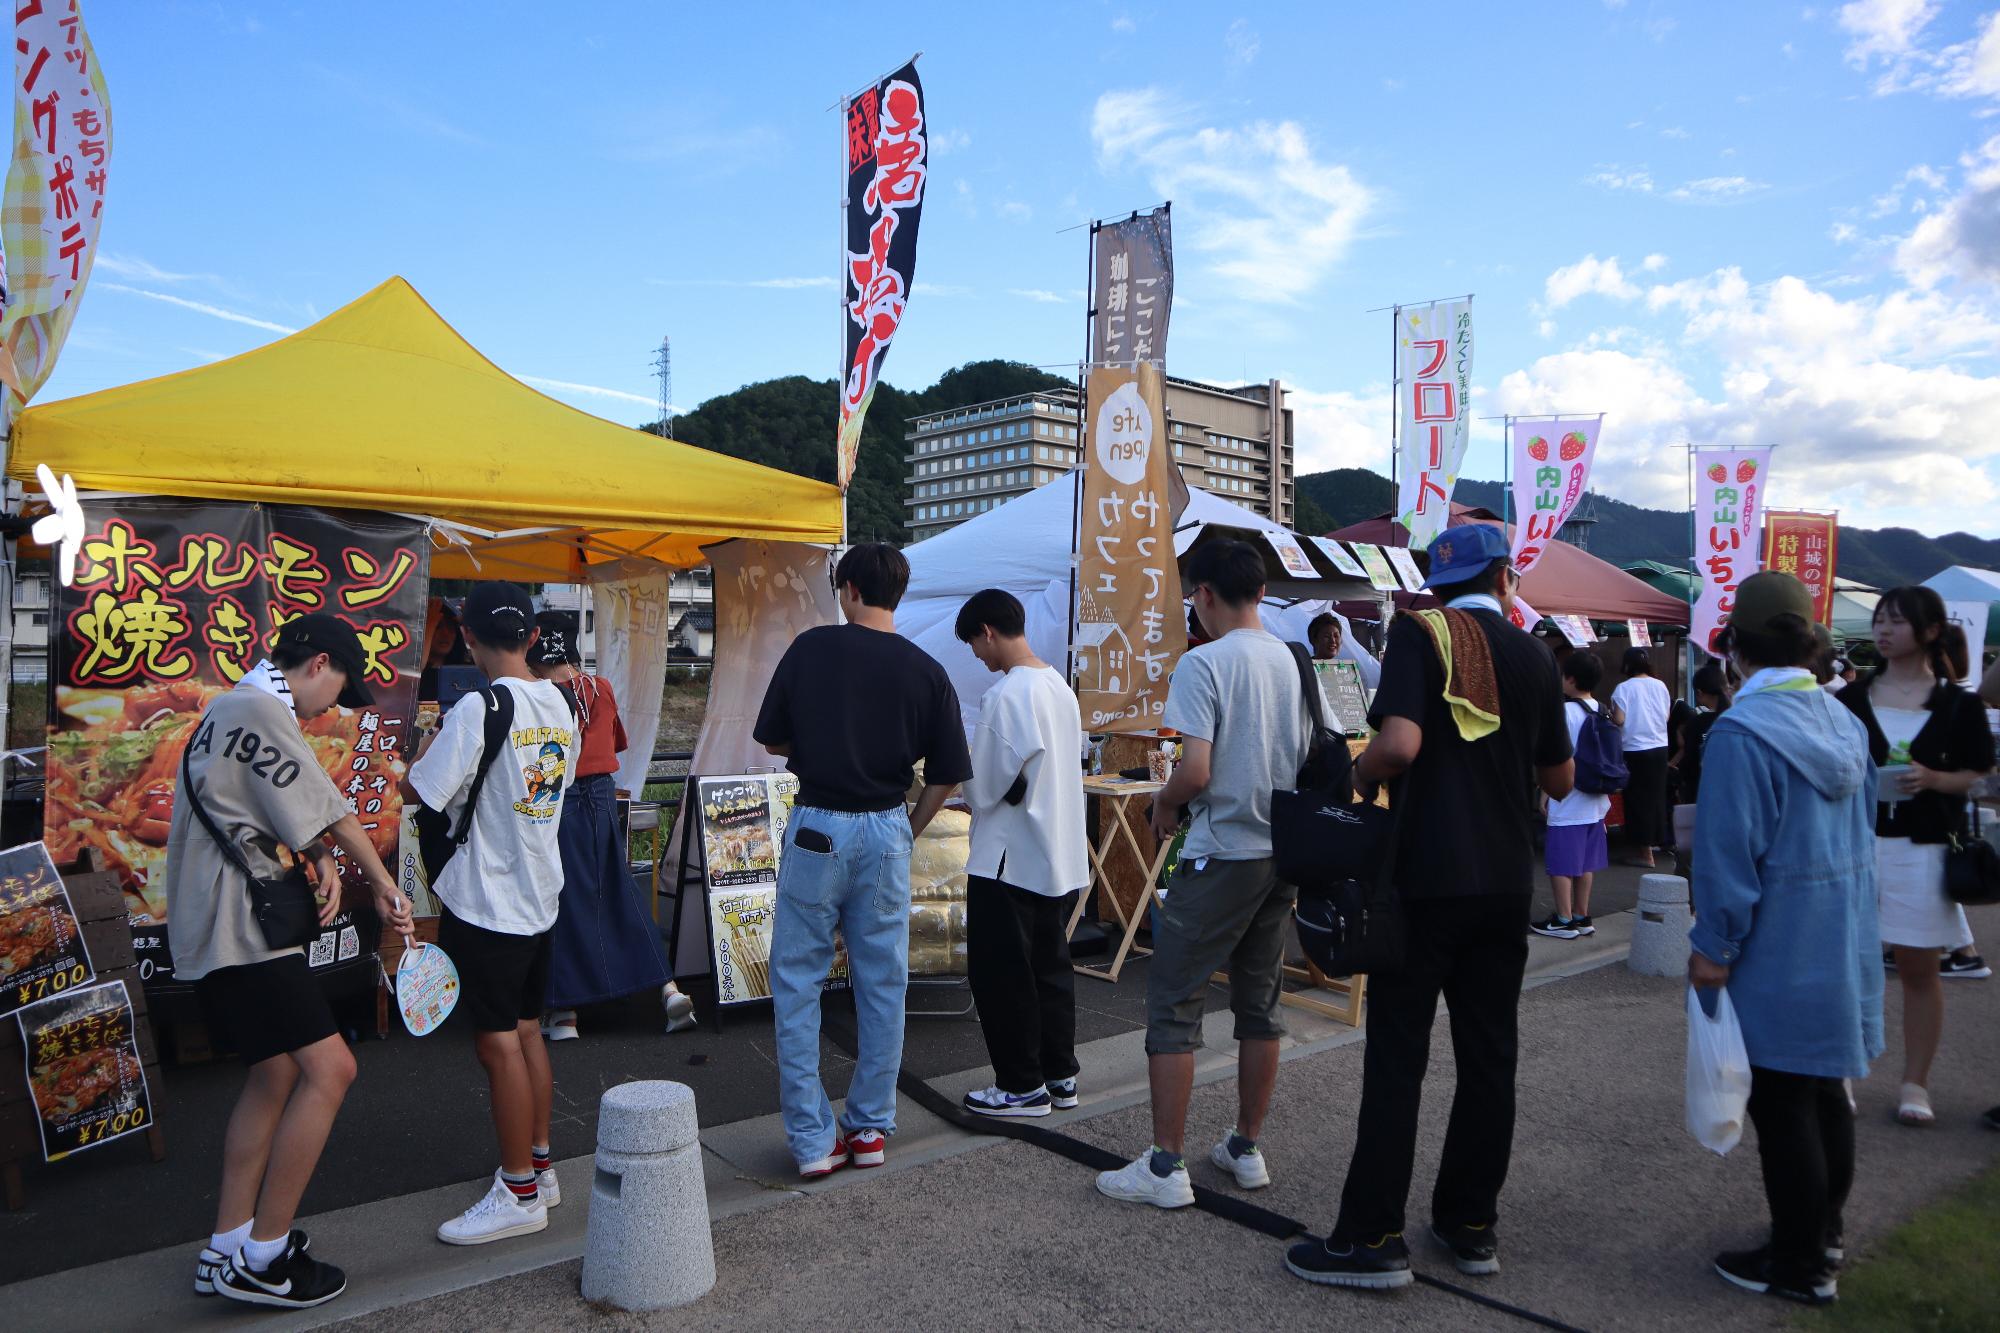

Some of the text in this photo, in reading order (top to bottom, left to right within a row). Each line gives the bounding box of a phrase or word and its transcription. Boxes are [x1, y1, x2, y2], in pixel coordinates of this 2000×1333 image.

[1413, 338, 1456, 517] フロート
[76, 519, 416, 607] ホルモン
[1777, 535, 1799, 574] 特製
[537, 727, 551, 743] IT
[223, 727, 301, 788] 1920
[37, 1007, 124, 1043] ホルモン
[38, 1025, 124, 1063] 焼きそば
